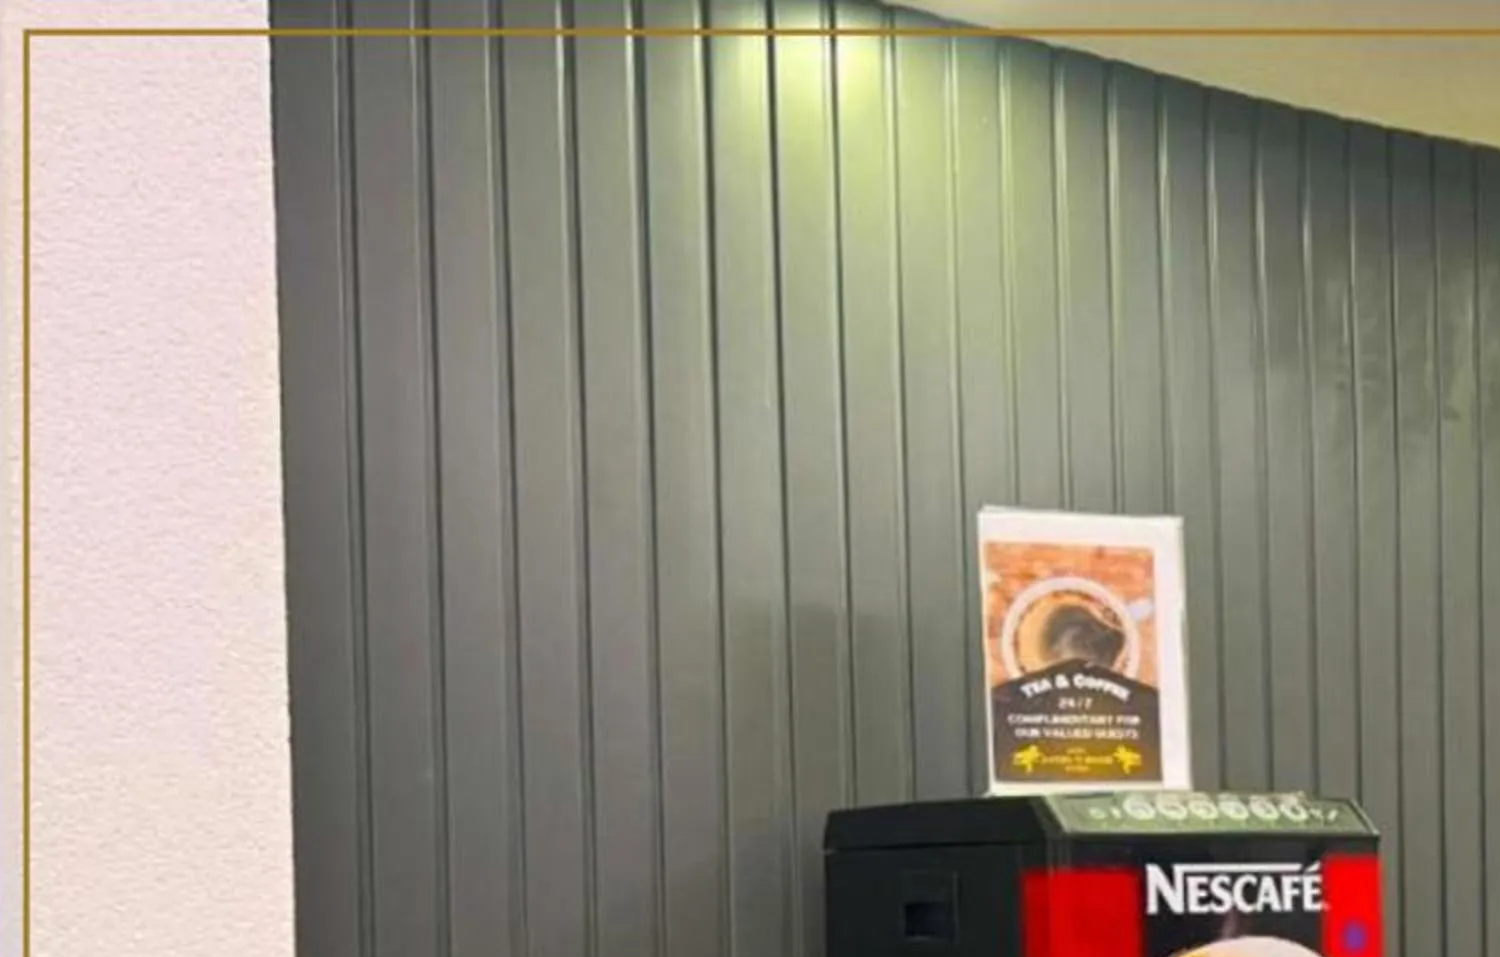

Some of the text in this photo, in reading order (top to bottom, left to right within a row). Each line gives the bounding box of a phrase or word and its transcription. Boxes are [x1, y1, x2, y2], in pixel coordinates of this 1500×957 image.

[1020, 679, 1052, 698] TEA
[1054, 674, 1070, 689] &
[1145, 860, 1325, 915] NESCAFÉ
